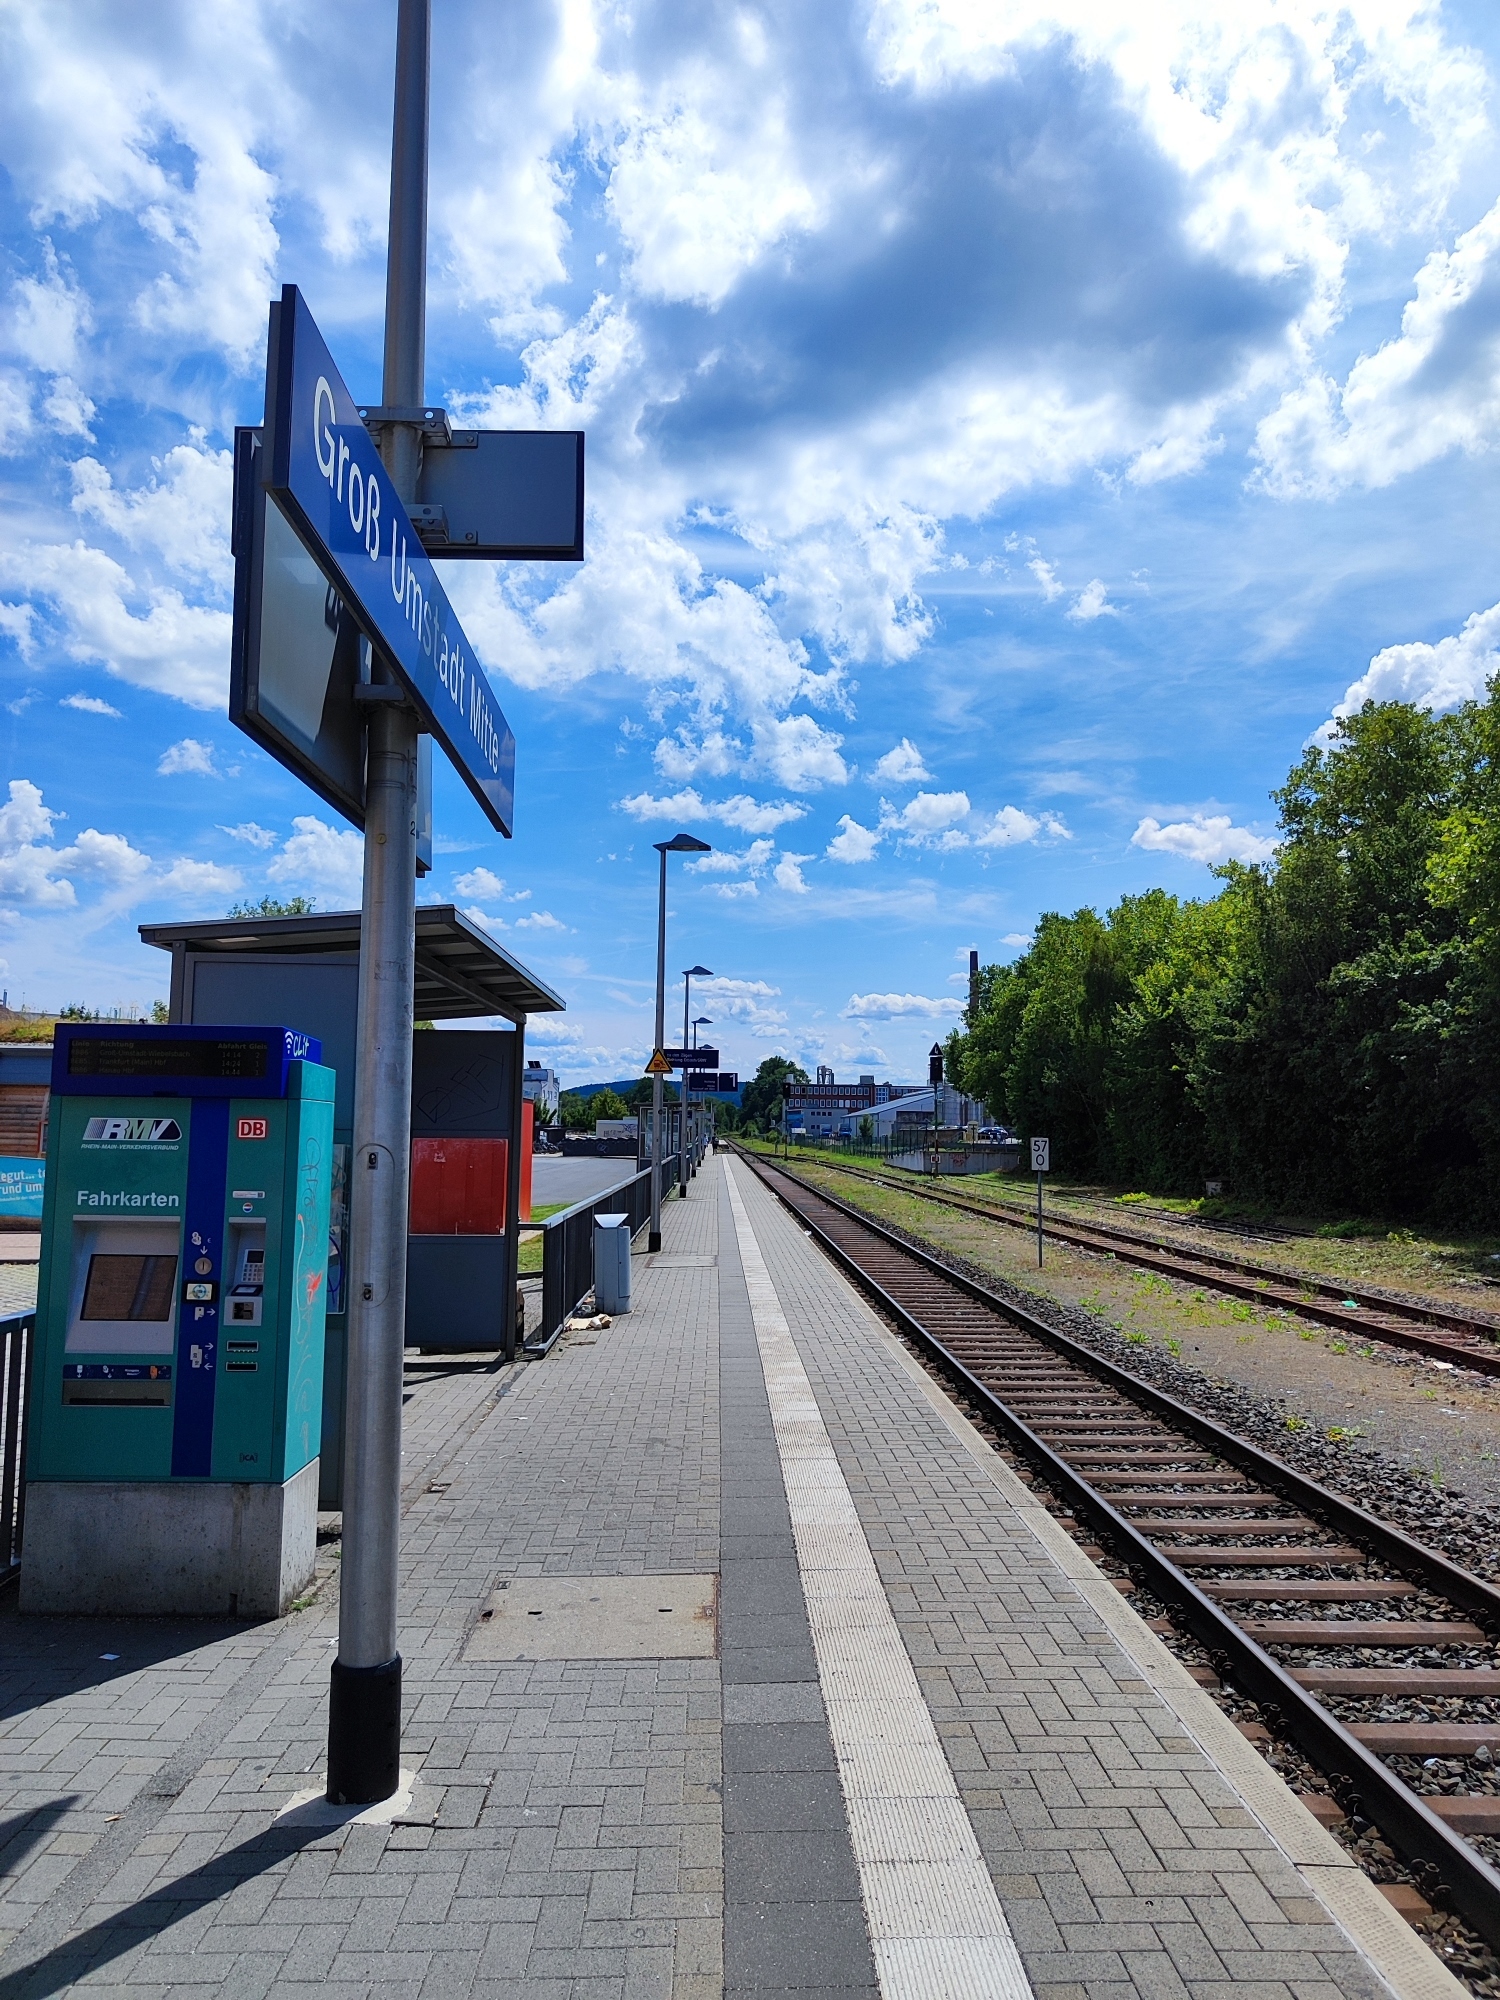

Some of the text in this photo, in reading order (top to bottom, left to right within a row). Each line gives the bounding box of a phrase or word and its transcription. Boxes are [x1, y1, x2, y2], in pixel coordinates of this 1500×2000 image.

[314, 376, 499, 774] Groß Umstadt Mitte
[100, 1041, 135, 1049] Richtung
[729, 1073, 735, 1087] 1
[100, 1119, 265, 1140] RMV DB
[80, 1143, 180, 1151] RHEIN-MAIN-VERKEHRSVERBUND
[1032, 1140, 1047, 1152] 57
[1035, 1154, 1045, 1166] 0
[25, 1183, 42, 1193] um
[77, 1190, 180, 1207] Fahrkarten
